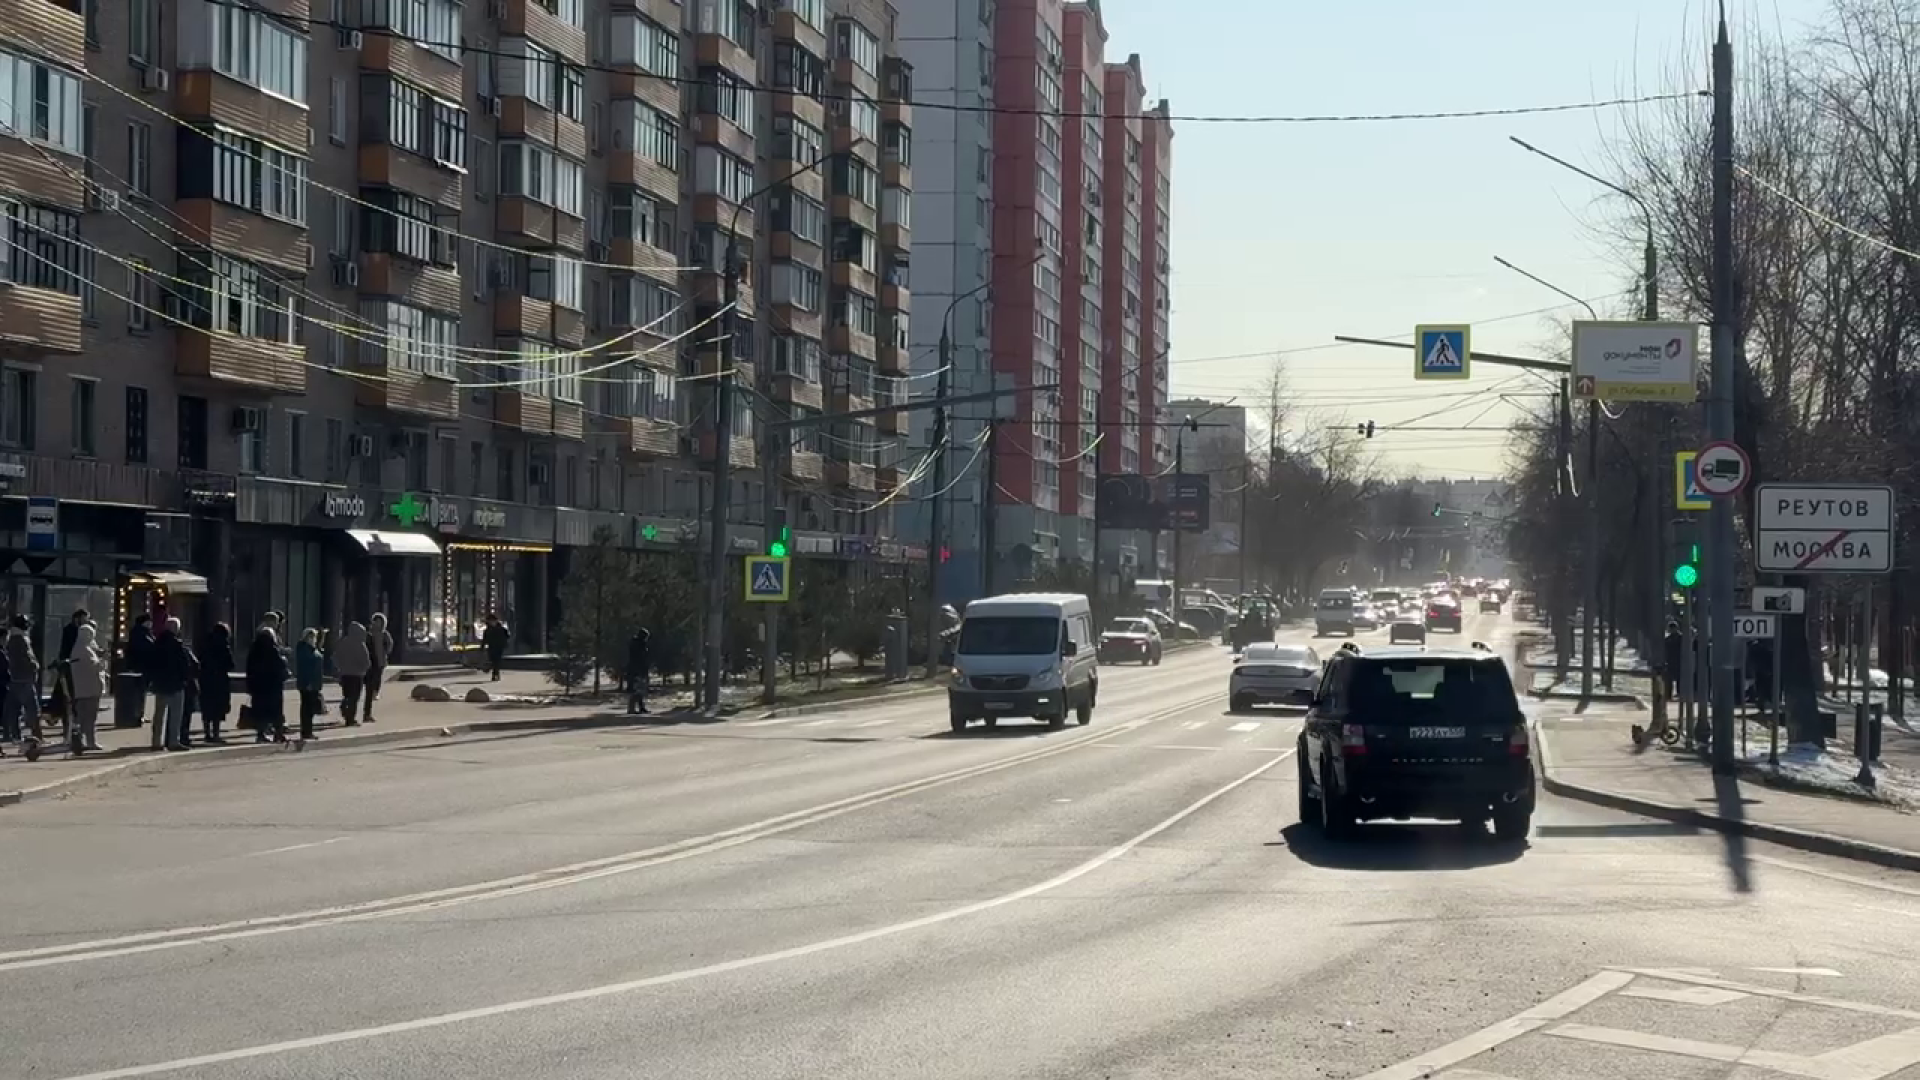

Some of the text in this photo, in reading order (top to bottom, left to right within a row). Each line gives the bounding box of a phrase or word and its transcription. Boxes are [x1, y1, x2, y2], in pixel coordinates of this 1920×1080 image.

[325, 492, 365, 517] lamoda
[1778, 499, 1869, 517] РЕУТОВ
[1773, 541, 1872, 559] МОСКВА
[1734, 619, 1768, 634] ТОП
